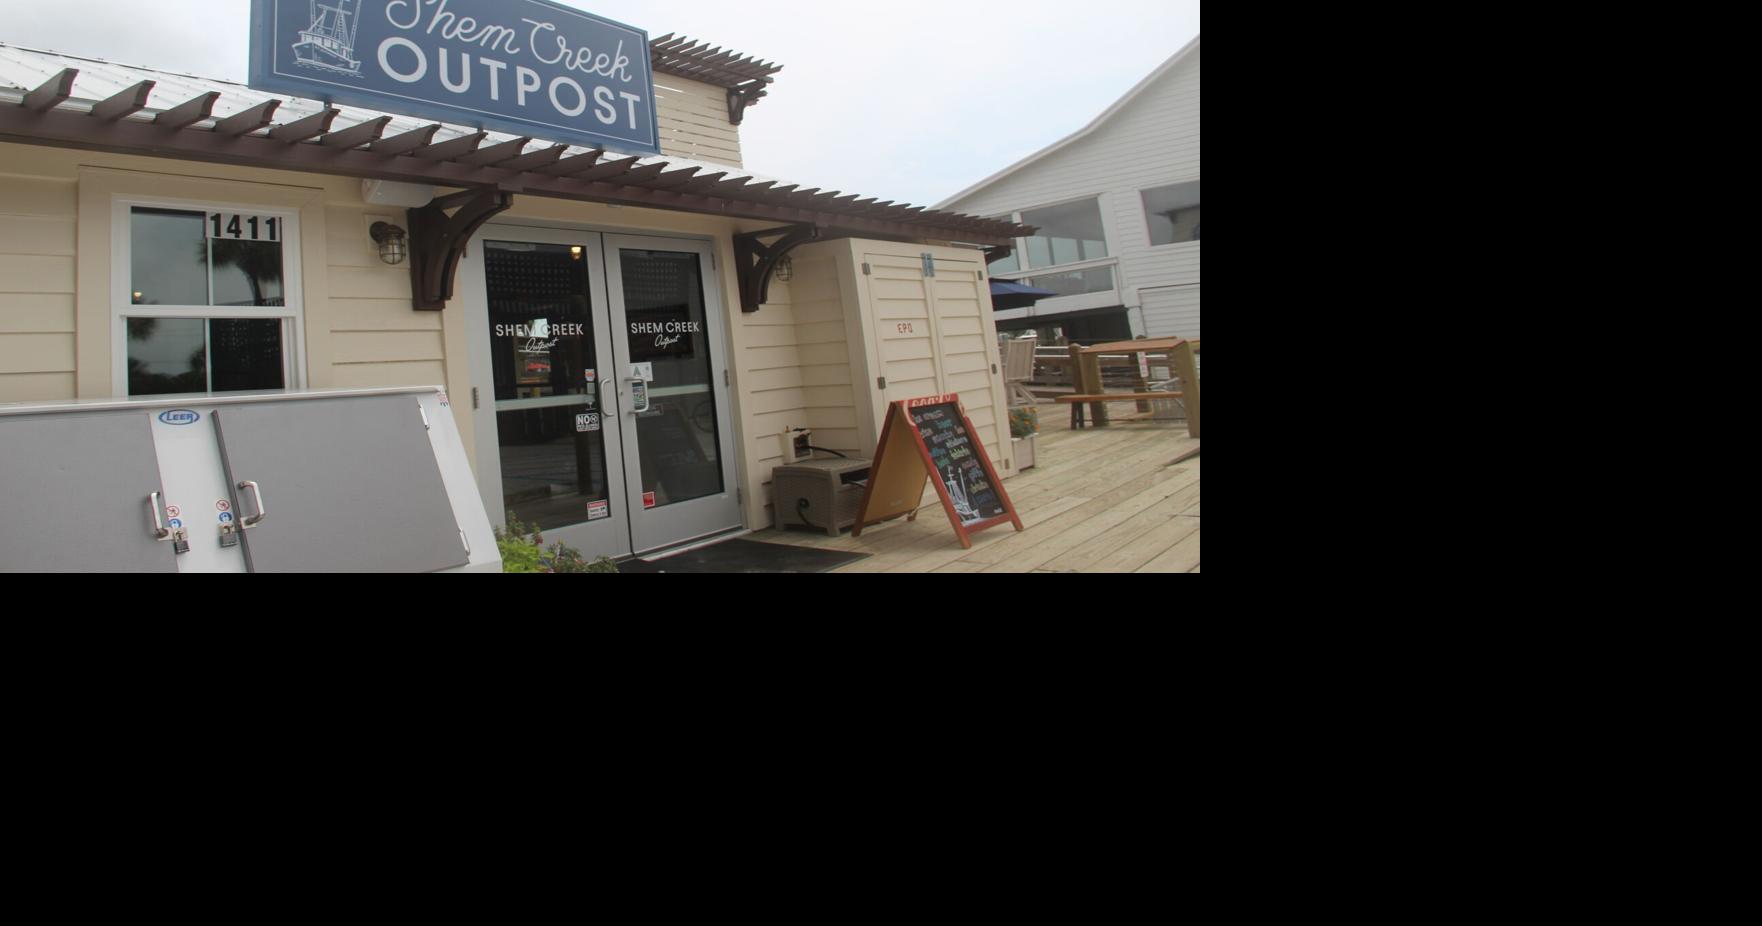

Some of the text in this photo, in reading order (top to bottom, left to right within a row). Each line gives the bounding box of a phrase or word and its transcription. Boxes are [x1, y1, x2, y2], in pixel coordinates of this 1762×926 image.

[384, 0, 633, 83] Shem Creek
[377, 36, 641, 130] OUTPOST
[209, 213, 277, 241] 1411
[495, 323, 584, 337] SHEM CREEK
[631, 321, 700, 335] SHEM CREEK
[525, 337, 560, 354] Outpost
[654, 334, 681, 349] Outpost
[166, 410, 194, 422] LEER
